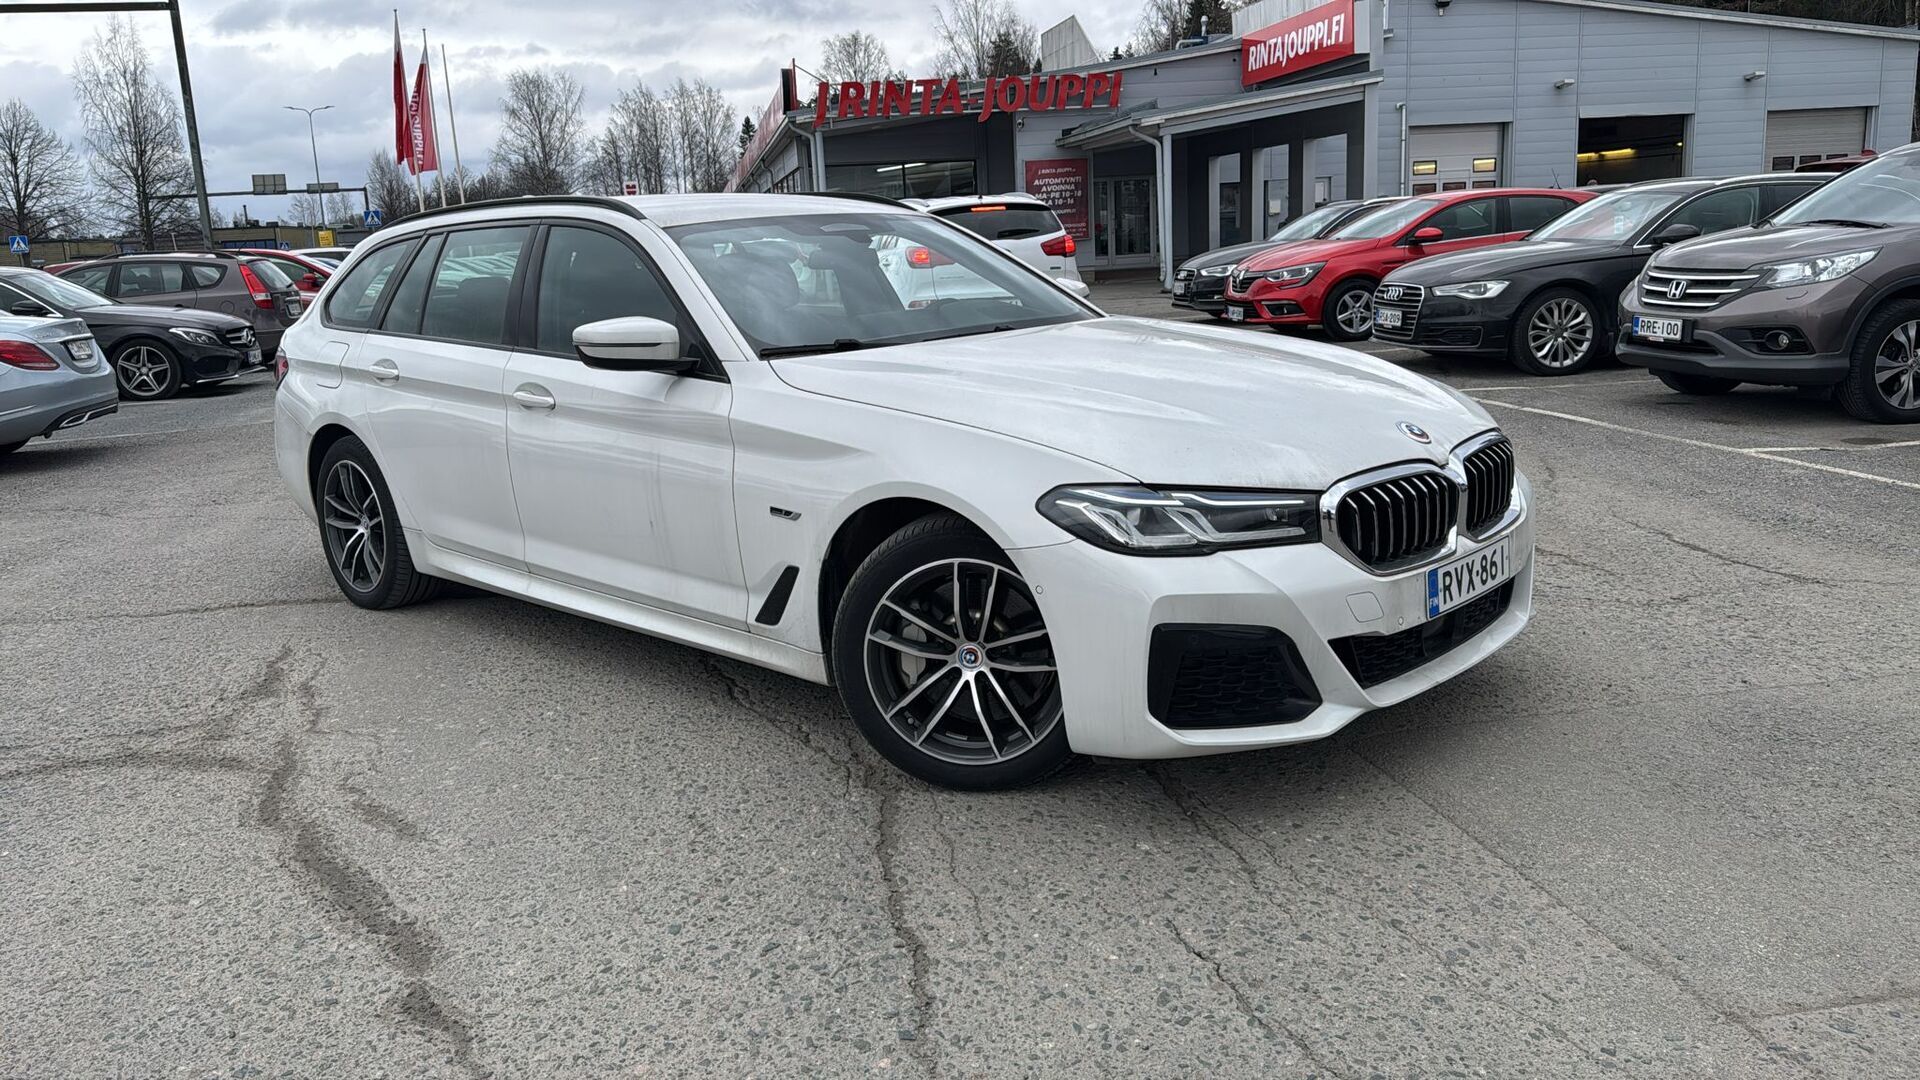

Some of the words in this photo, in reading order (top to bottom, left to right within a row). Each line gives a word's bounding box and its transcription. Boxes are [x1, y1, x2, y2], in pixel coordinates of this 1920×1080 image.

[1248, 13, 1345, 72] RINTAJOUPPI.FI
[813, 81, 829, 128] J
[838, 71, 1123, 123] RINTA-JOUPPI
[1034, 176, 1081, 185] AUTOMYYNTI
[1041, 184, 1075, 192] AVOINNA
[1640, 319, 1679, 336] RRE-100
[1442, 545, 1505, 606] RVX-861
